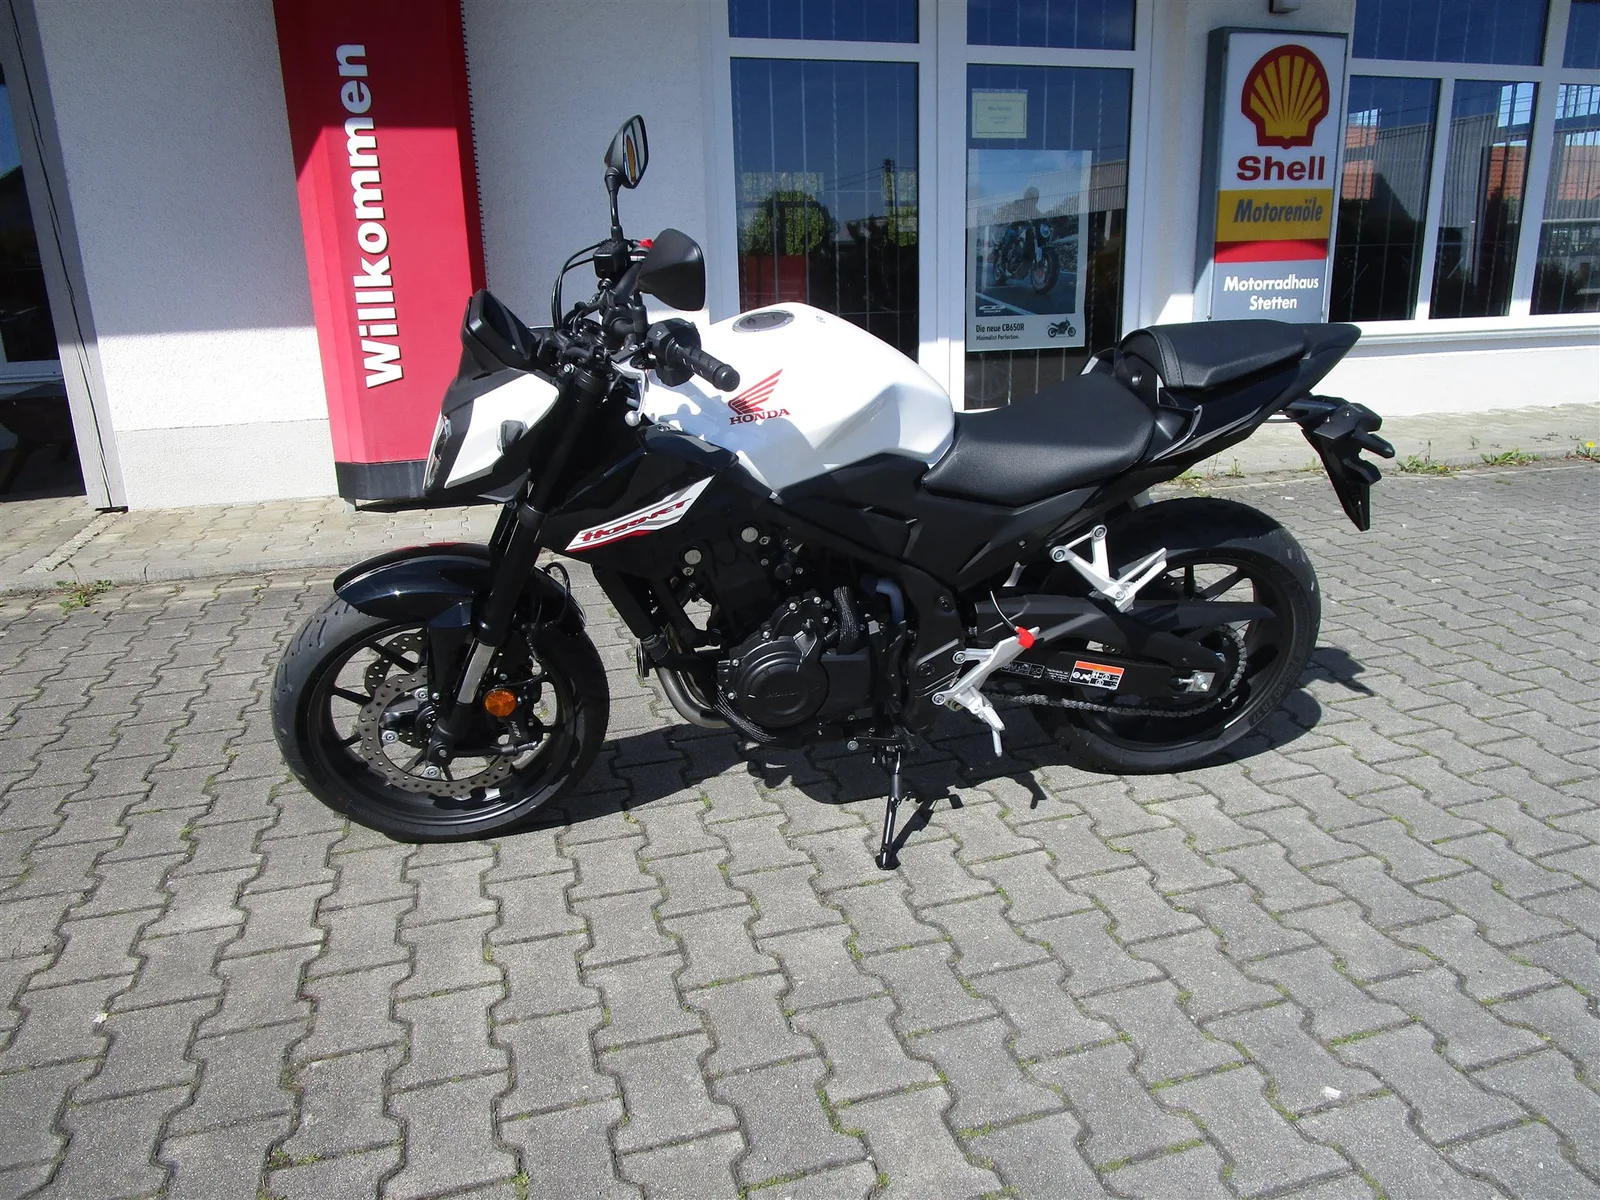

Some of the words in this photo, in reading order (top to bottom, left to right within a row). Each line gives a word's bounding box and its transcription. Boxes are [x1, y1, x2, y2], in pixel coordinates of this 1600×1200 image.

[1236, 155, 1325, 181] Shell
[335, 43, 405, 389] Willkommen
[1233, 197, 1324, 223] Motorenöle
[1223, 274, 1319, 292] Motorradhaus
[1249, 295, 1297, 311] Stetten
[976, 324, 985, 332] Die
[1002, 323, 1025, 332] CB650R
[729, 408, 791, 426] HONDA
